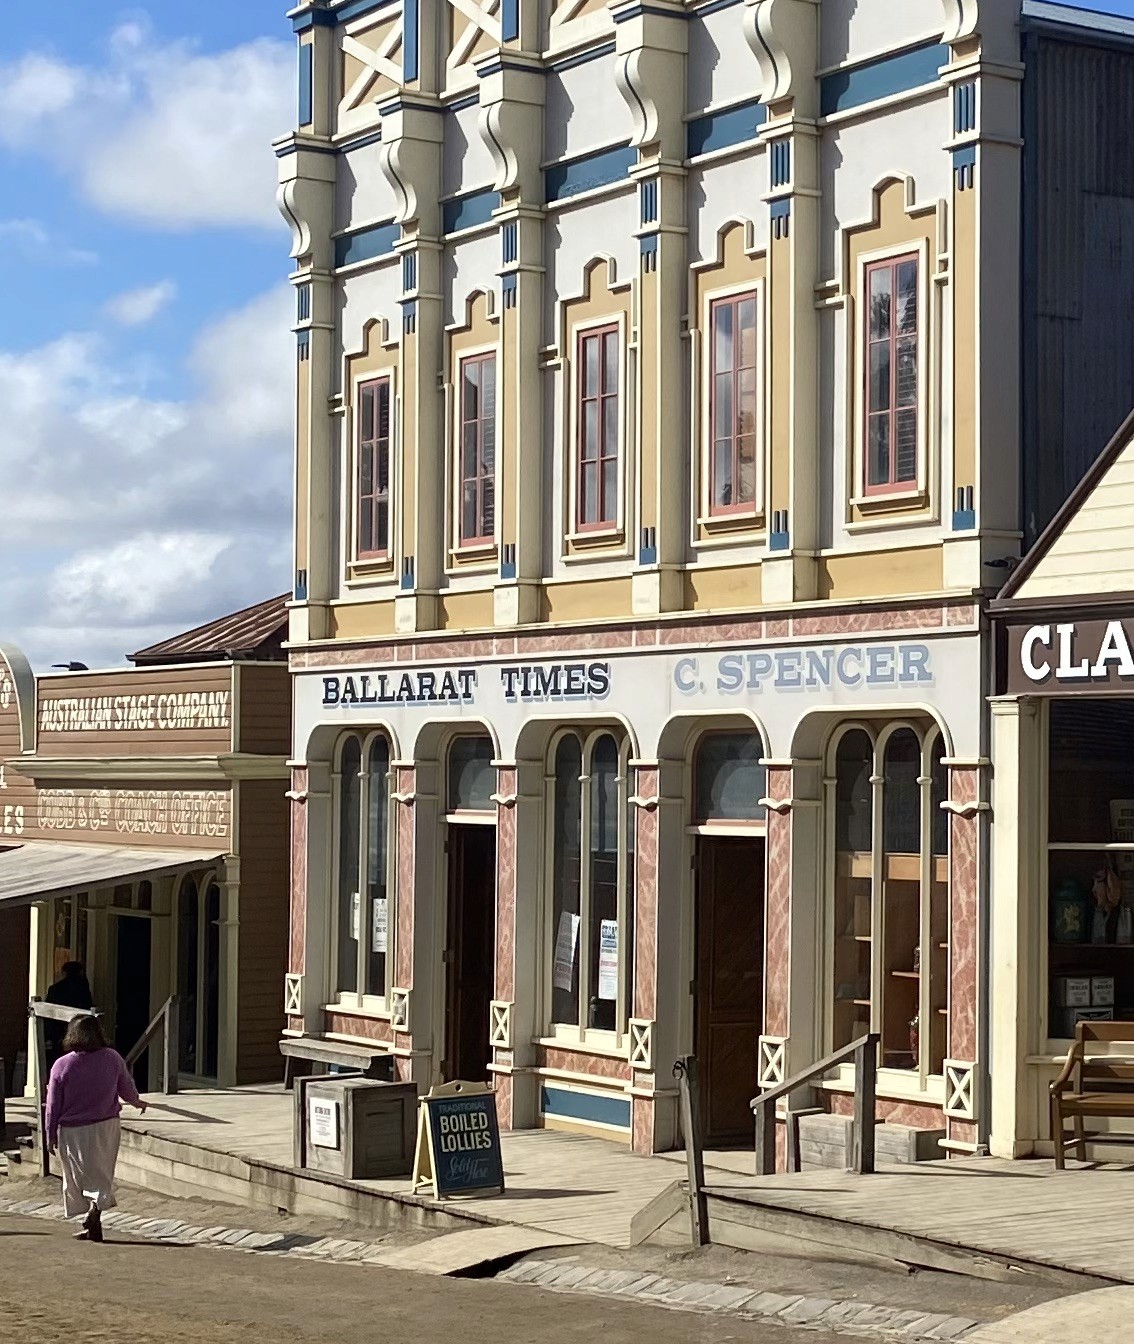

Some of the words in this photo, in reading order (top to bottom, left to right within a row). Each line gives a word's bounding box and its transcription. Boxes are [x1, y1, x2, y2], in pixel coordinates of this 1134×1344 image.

[322, 669, 477, 706] BALLARAT
[501, 662, 610, 700] TIMES
[674, 658, 704, 692] C.
[717, 644, 934, 691] SPENCER
[41, 697, 112, 732] AUSTRALIAN
[114, 694, 156, 730] STAGE
[38, 789, 75, 830] COBB
[115, 789, 168, 834] COACH
[171, 791, 228, 836] OFFICE
[440, 1112, 488, 1133] BOILED
[441, 1131, 492, 1152] LOLLIES
